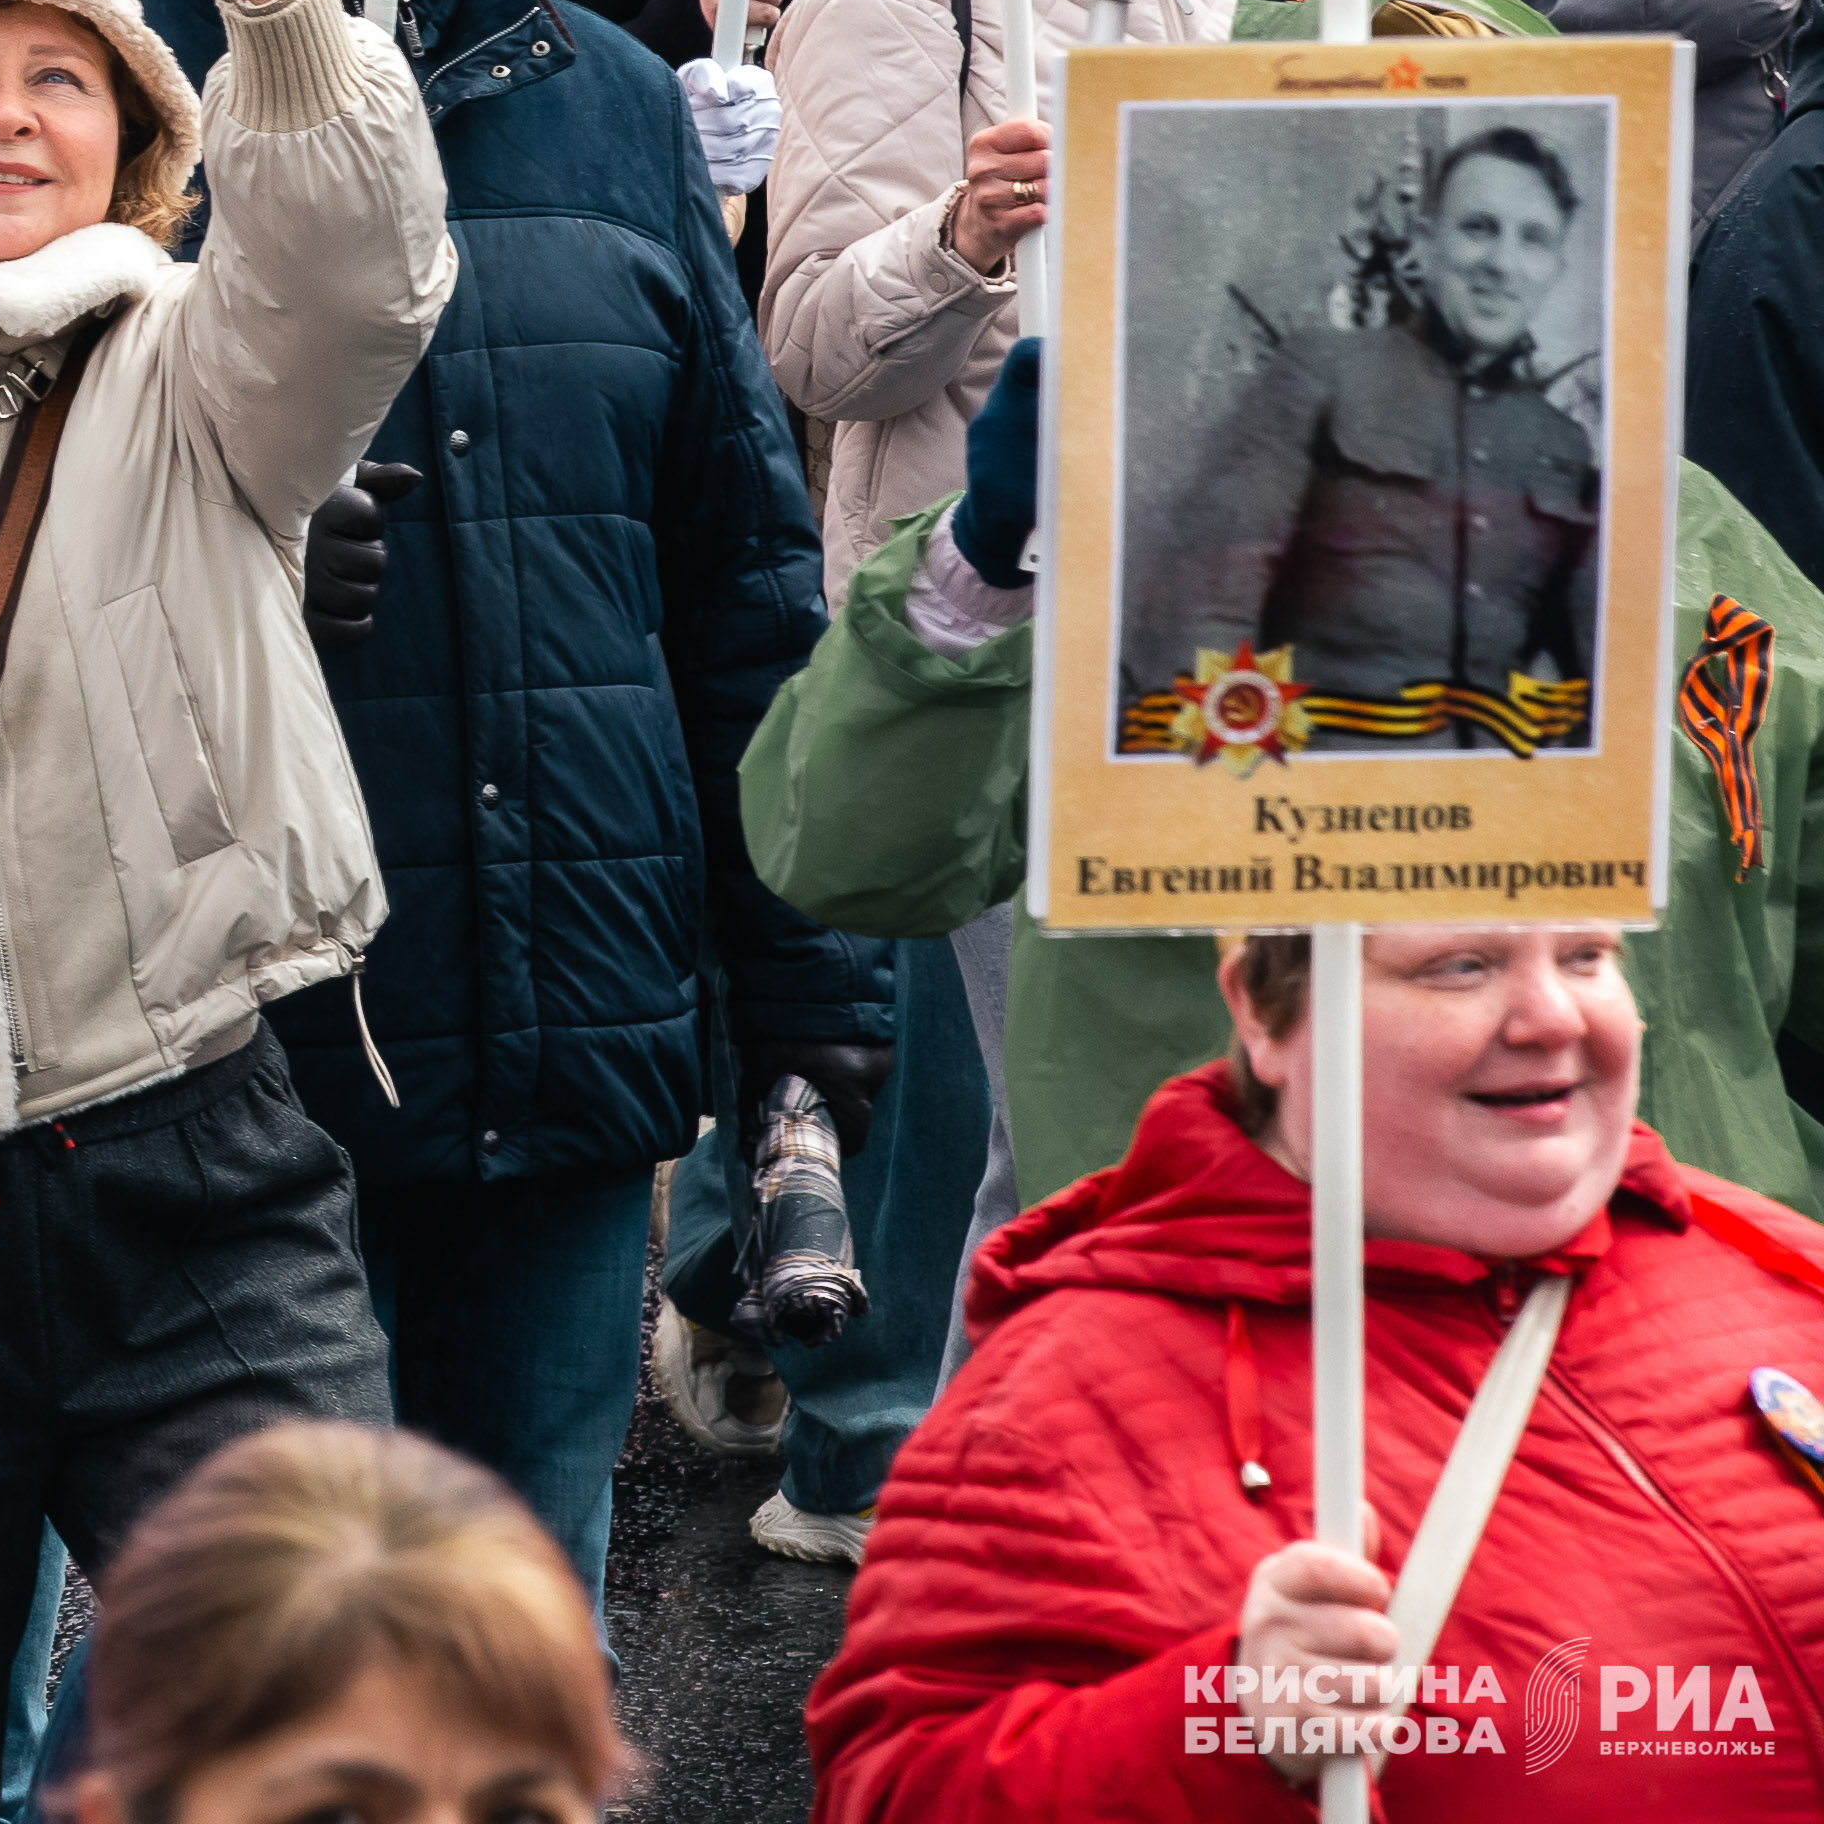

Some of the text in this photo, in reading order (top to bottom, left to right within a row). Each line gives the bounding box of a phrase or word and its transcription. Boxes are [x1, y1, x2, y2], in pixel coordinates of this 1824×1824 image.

[1253, 795, 1473, 846] Кузнецов
[1075, 854, 1648, 902] Евгений Владимирович
